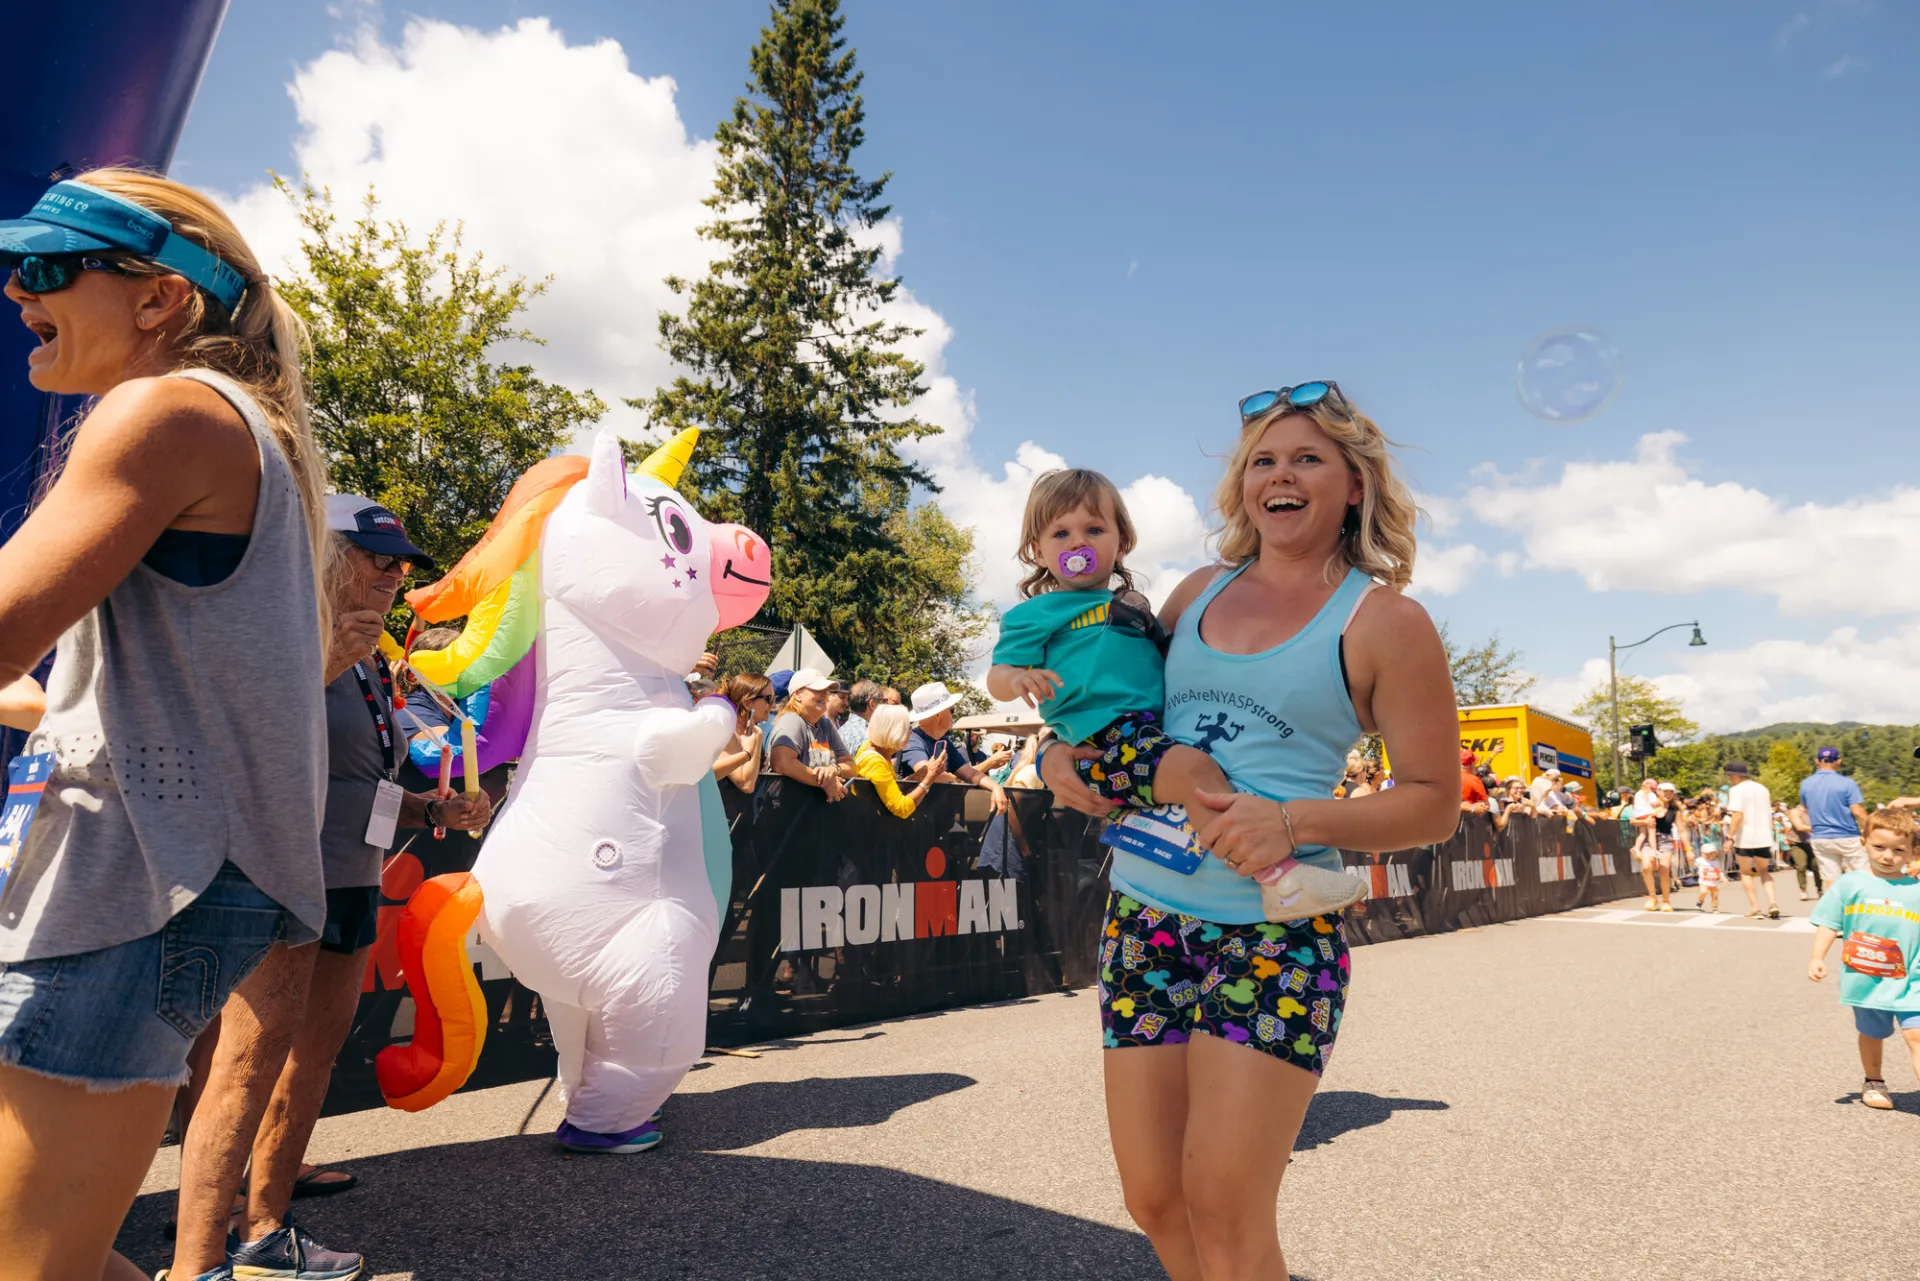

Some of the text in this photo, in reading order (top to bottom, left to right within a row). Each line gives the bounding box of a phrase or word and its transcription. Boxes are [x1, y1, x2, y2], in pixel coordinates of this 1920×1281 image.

[1167, 689, 1295, 739] #WeAreNYASPstrong
[1460, 737, 1504, 752] SKE
[1113, 772, 1130, 790] 5K
[1346, 852, 1415, 900] NMAN
[1452, 842, 1515, 892] IRONMAN
[780, 847, 1018, 952] IRONMAN
[1865, 903, 1903, 918] 2024
[1138, 1014, 1164, 1036] 5K
